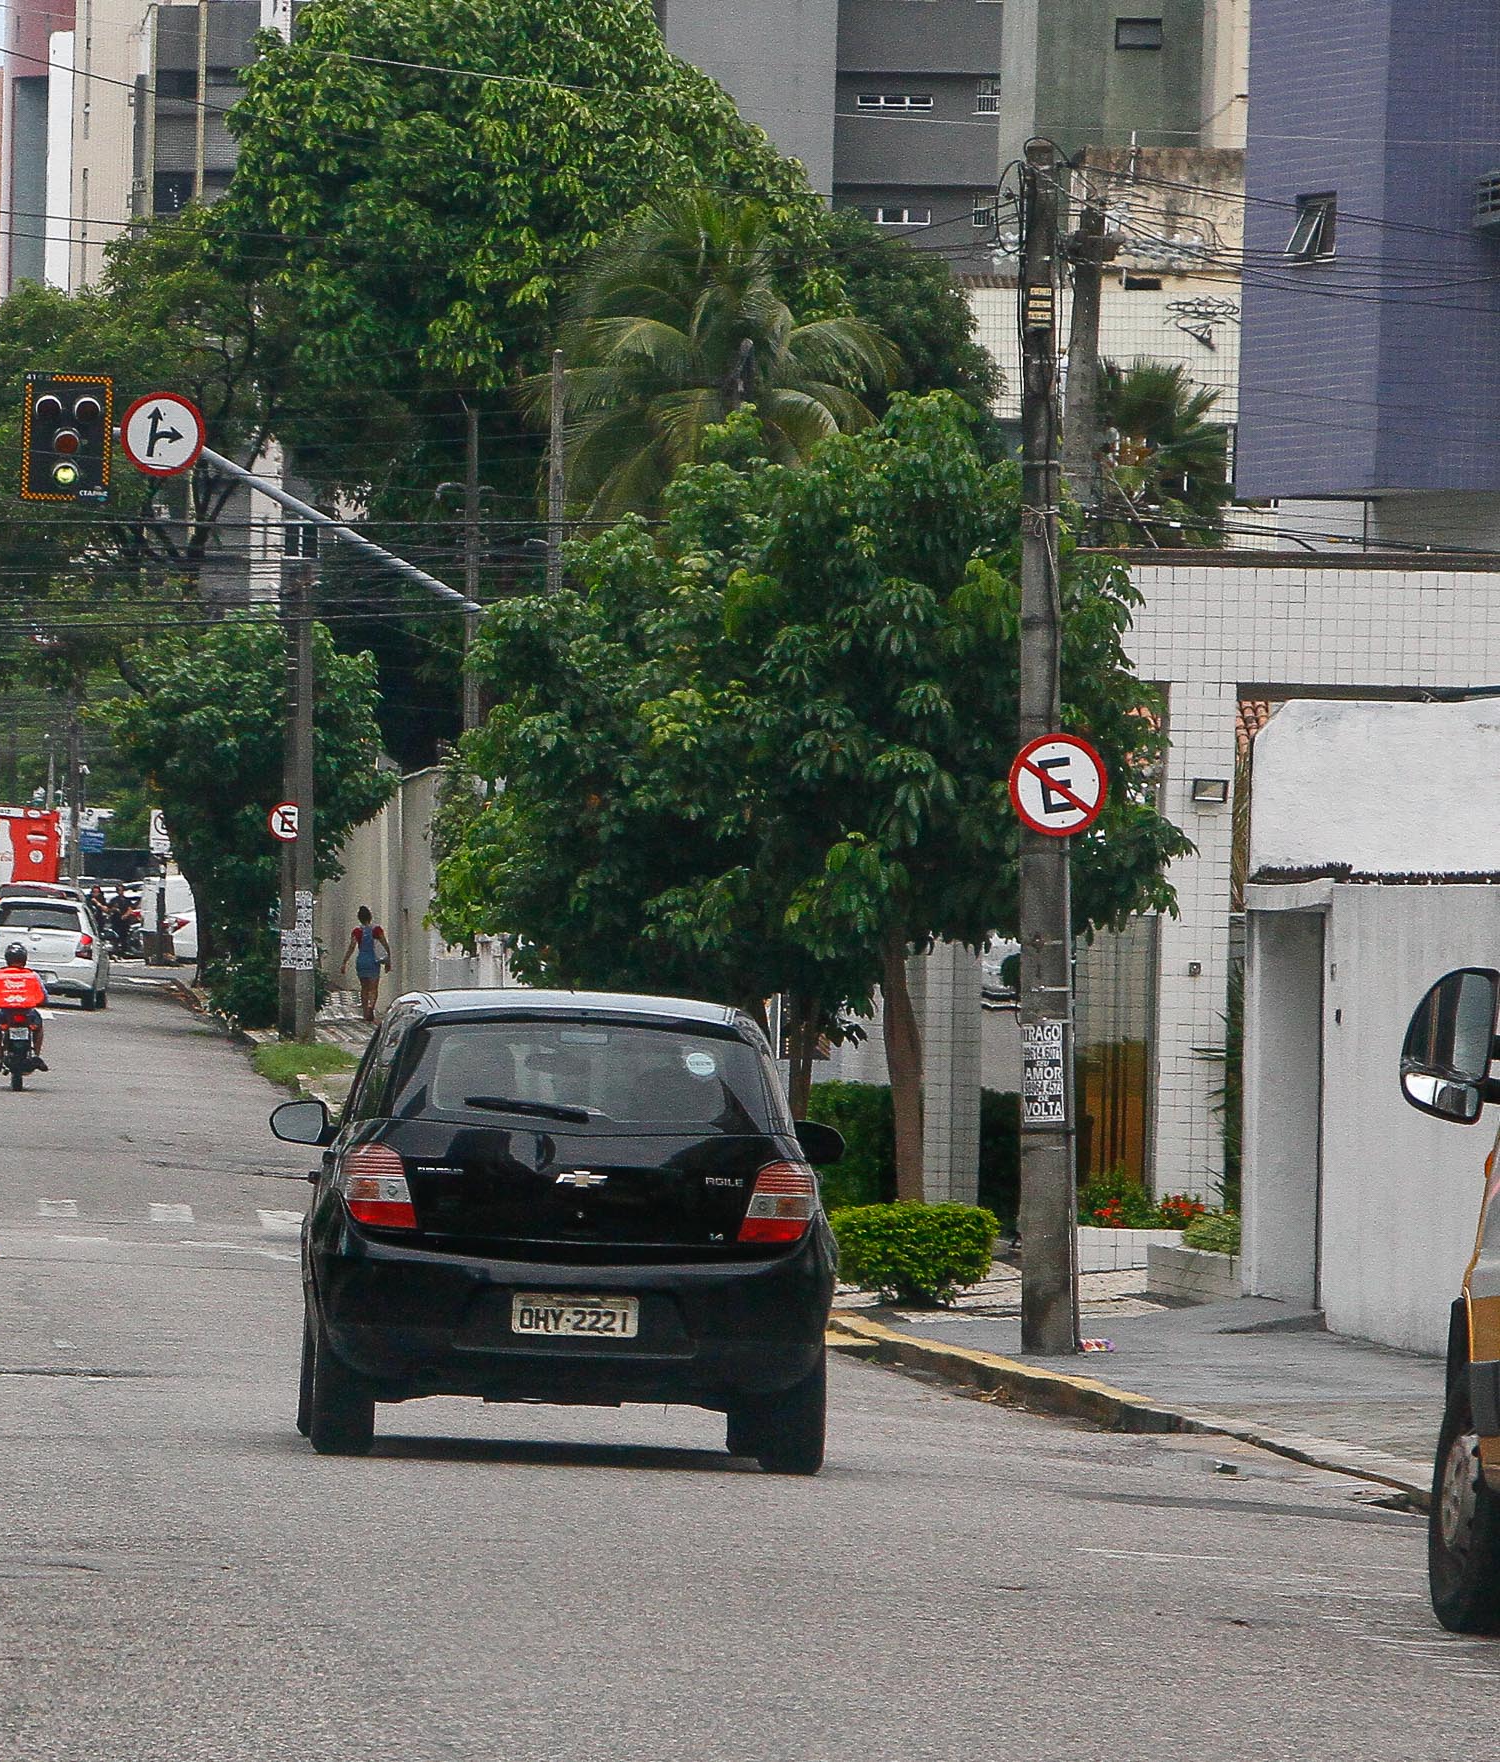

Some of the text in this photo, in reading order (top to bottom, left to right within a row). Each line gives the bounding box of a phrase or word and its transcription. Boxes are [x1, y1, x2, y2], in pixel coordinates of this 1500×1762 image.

[1023, 1026, 1060, 1042] TRAGO
[1025, 1067, 1062, 1080] AMOR
[1026, 1102, 1062, 1115] VOLTA
